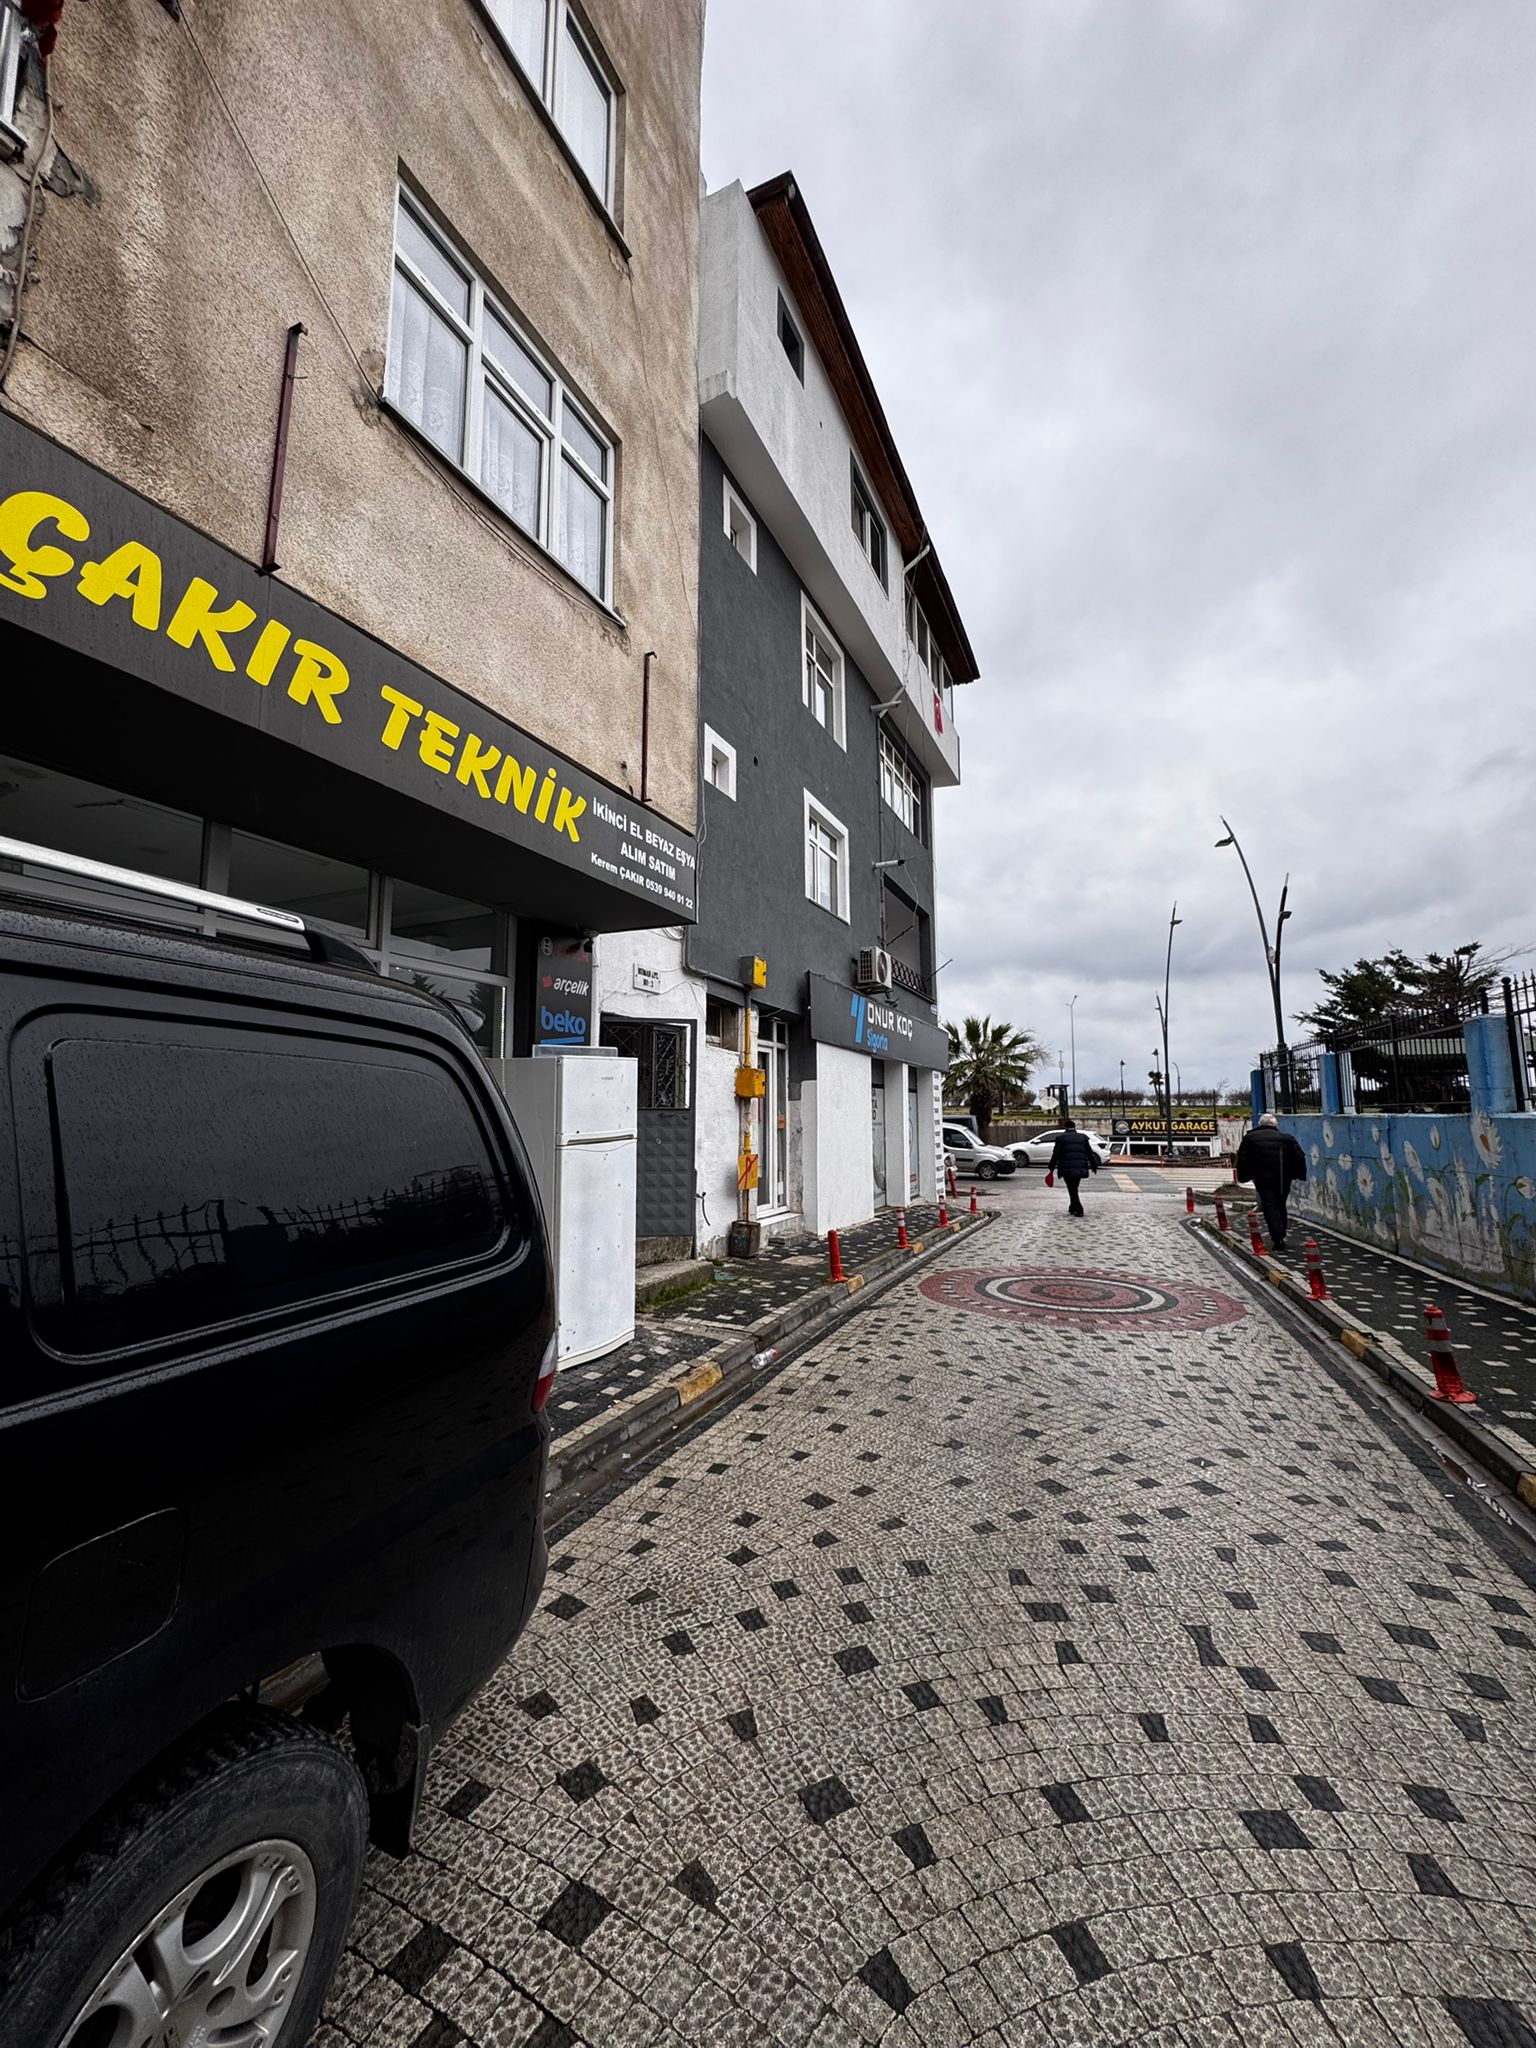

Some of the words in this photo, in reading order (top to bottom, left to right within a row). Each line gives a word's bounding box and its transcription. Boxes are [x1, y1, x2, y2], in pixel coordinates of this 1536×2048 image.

[0, 491, 350, 724] ÇAKIR
[381, 685, 587, 842] TEKNİK
[593, 797, 627, 832] İKİNCİ
[629, 821, 643, 840] EL
[645, 829, 675, 857] BEYAZ
[675, 847, 696, 870] EŞYA
[591, 852, 618, 875] Kerem
[619, 866, 645, 887] ÇAKIR
[645, 878, 663, 895] 0539
[663, 887, 676, 901] 940
[685, 897, 694, 909] 22
[620, 842, 647, 866] ALIM
[648, 856, 676, 880] SATIM
[553, 978, 589, 996] arçelik
[541, 1006, 586, 1035] beko
[867, 1002, 895, 1032] ONUR
[896, 1014, 913, 1042] KOÇ
[1131, 1121, 1167, 1131] AYKUT
[1171, 1121, 1215, 1131] GARAGE
